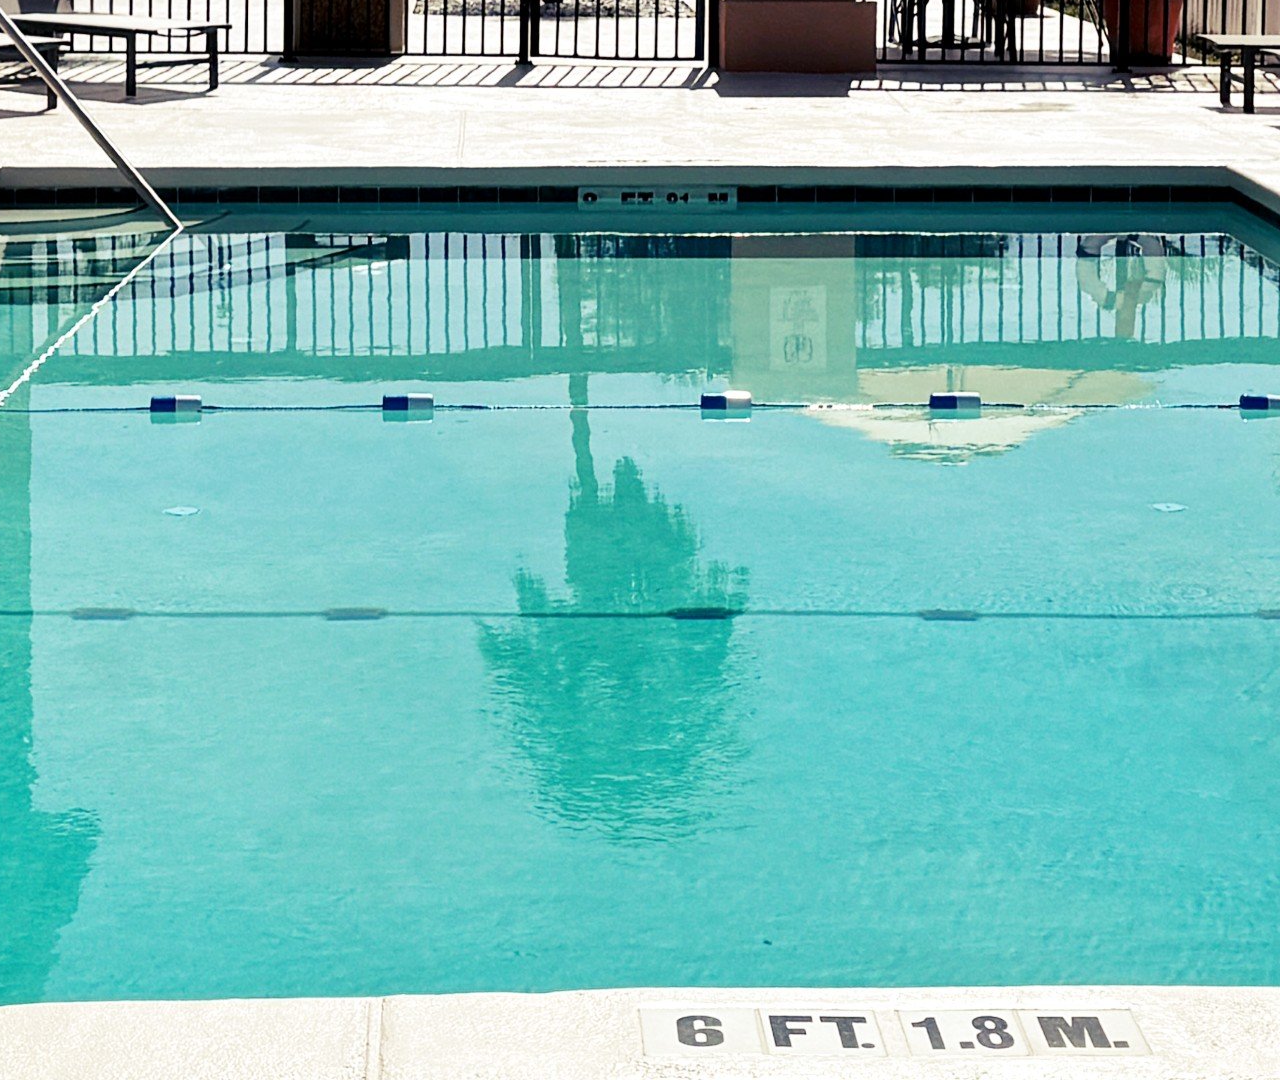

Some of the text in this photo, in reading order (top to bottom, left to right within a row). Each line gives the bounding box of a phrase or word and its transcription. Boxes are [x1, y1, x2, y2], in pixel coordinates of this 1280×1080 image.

[676, 1015, 1130, 1050] 6 FT. 1.8 M.
